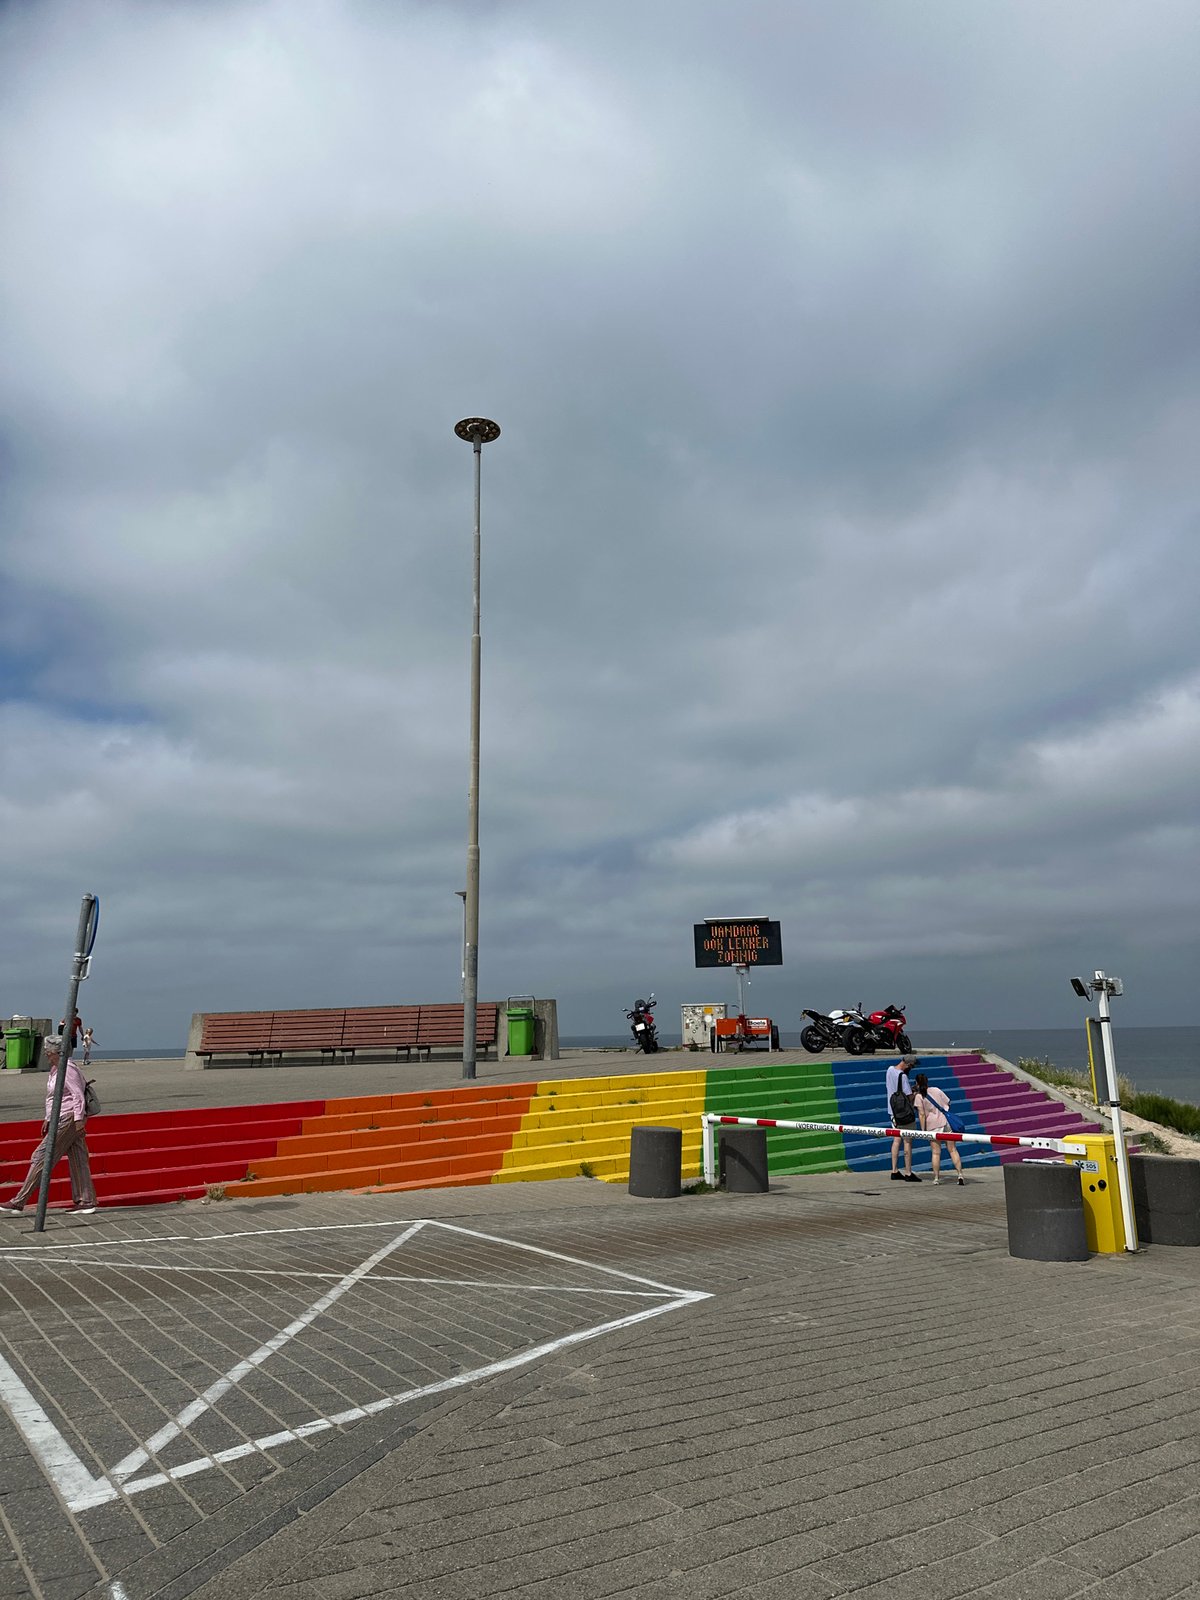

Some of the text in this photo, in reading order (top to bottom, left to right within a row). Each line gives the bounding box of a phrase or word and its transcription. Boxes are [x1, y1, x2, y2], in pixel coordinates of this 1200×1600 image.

[711, 924, 760, 938] VANDAAG
[703, 936, 769, 951] OOK LEKKER
[717, 949, 758, 963] ZONNIG
